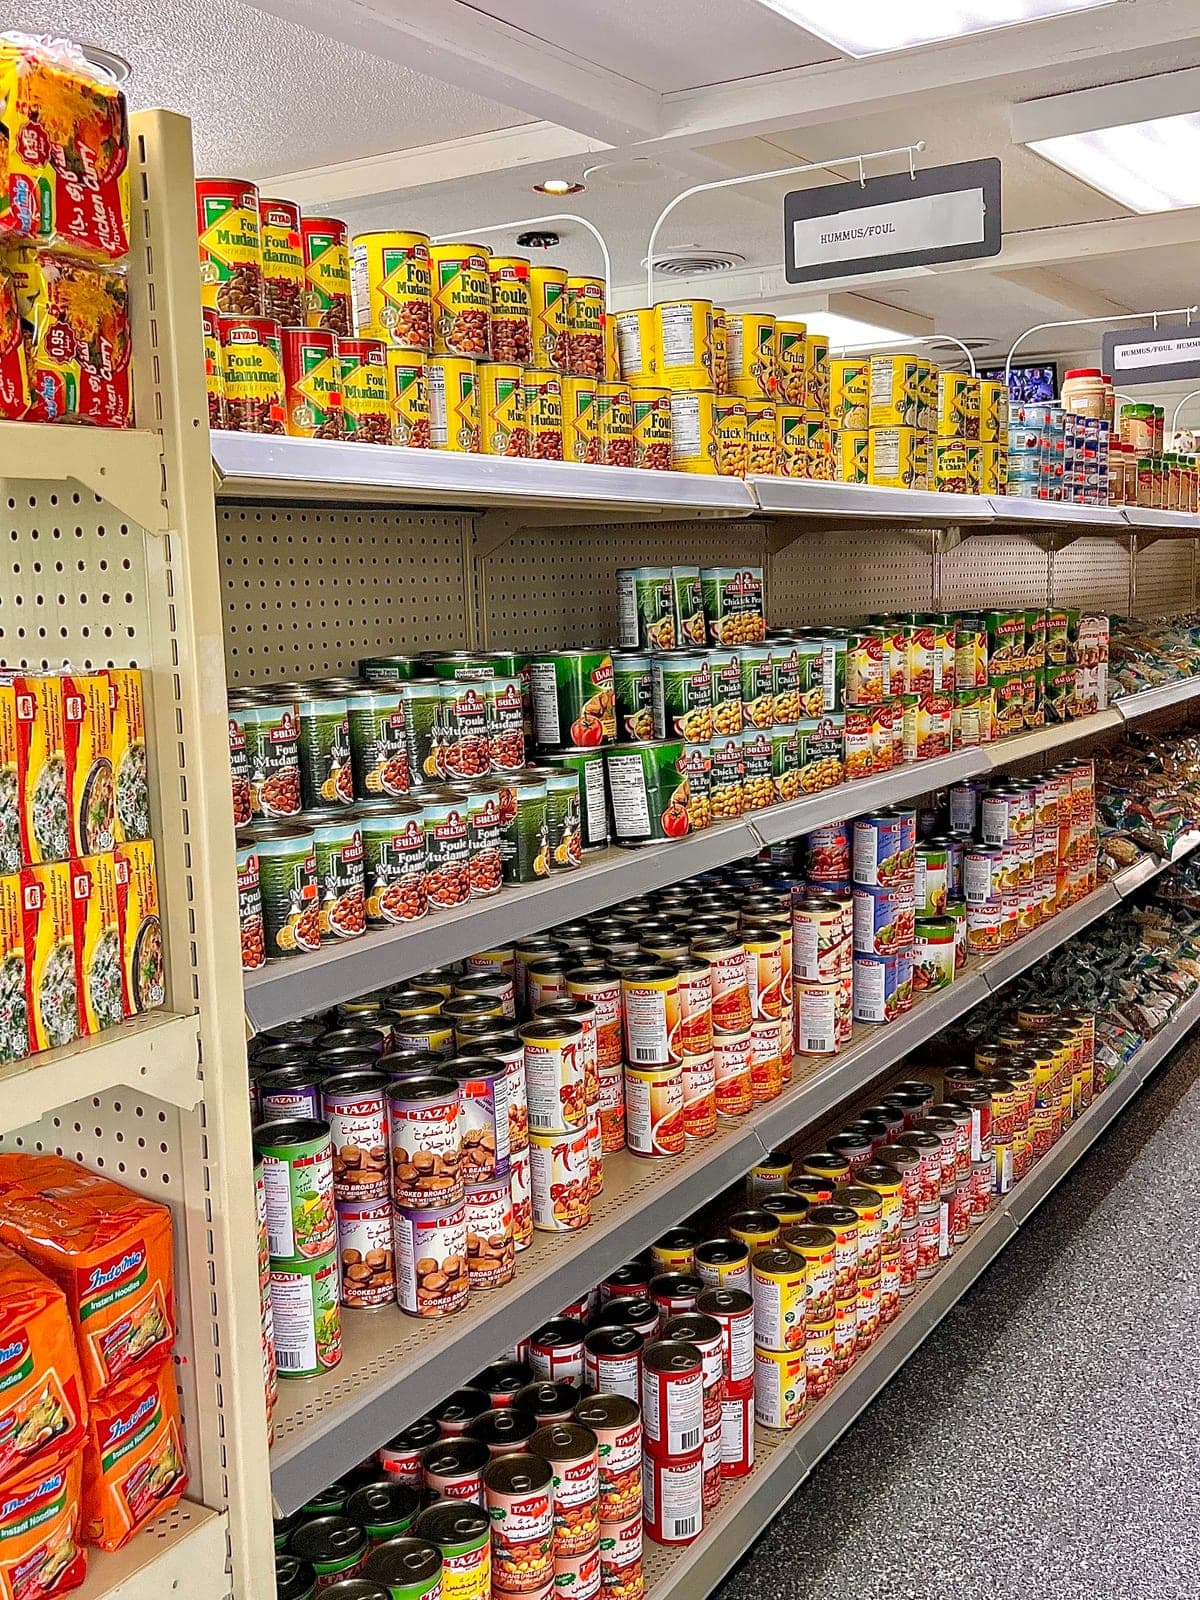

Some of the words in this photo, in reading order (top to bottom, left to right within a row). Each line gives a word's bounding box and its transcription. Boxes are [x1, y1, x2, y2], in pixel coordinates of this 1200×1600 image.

[77, 140, 100, 191] Curry
[269, 213, 291, 225] ZIYAD
[820, 223, 896, 245] HUMMUS/FOUL
[264, 235, 293, 250] Foul
[491, 286, 528, 304] Foule
[232, 331, 257, 340] ZIYAD
[52, 329, 65, 357] 0.95
[1121, 345, 1173, 357] HUMMUS/FOUL
[100, 336, 114, 382] Curry
[227, 354, 263, 367] Foule
[711, 767, 734, 776] Chick
[268, 1096, 300, 1104] TAZAH
[469, 1165, 491, 1174] BEANS
[350, 1182, 371, 1191] BROAD
[397, 1189, 422, 1199] COOKED
[423, 1187, 447, 1197] BROAD
[464, 1186, 507, 1203] TAZAH
[89, 1250, 143, 1289] Indomie
[469, 1269, 492, 1279] BROAD
[90, 1292, 115, 1310] Instant
[115, 1280, 141, 1300] Noodles
[347, 1288, 376, 1298] COOKED
[422, 1297, 452, 1307] COOKED
[109, 1395, 156, 1441] Indomie
[112, 1440, 134, 1461] Instant
[133, 1421, 157, 1444] Noodles
[672, 1462, 697, 1473] TAZAH
[2, 1475, 61, 1517] Indomie
[28, 1505, 60, 1529] Noodles
